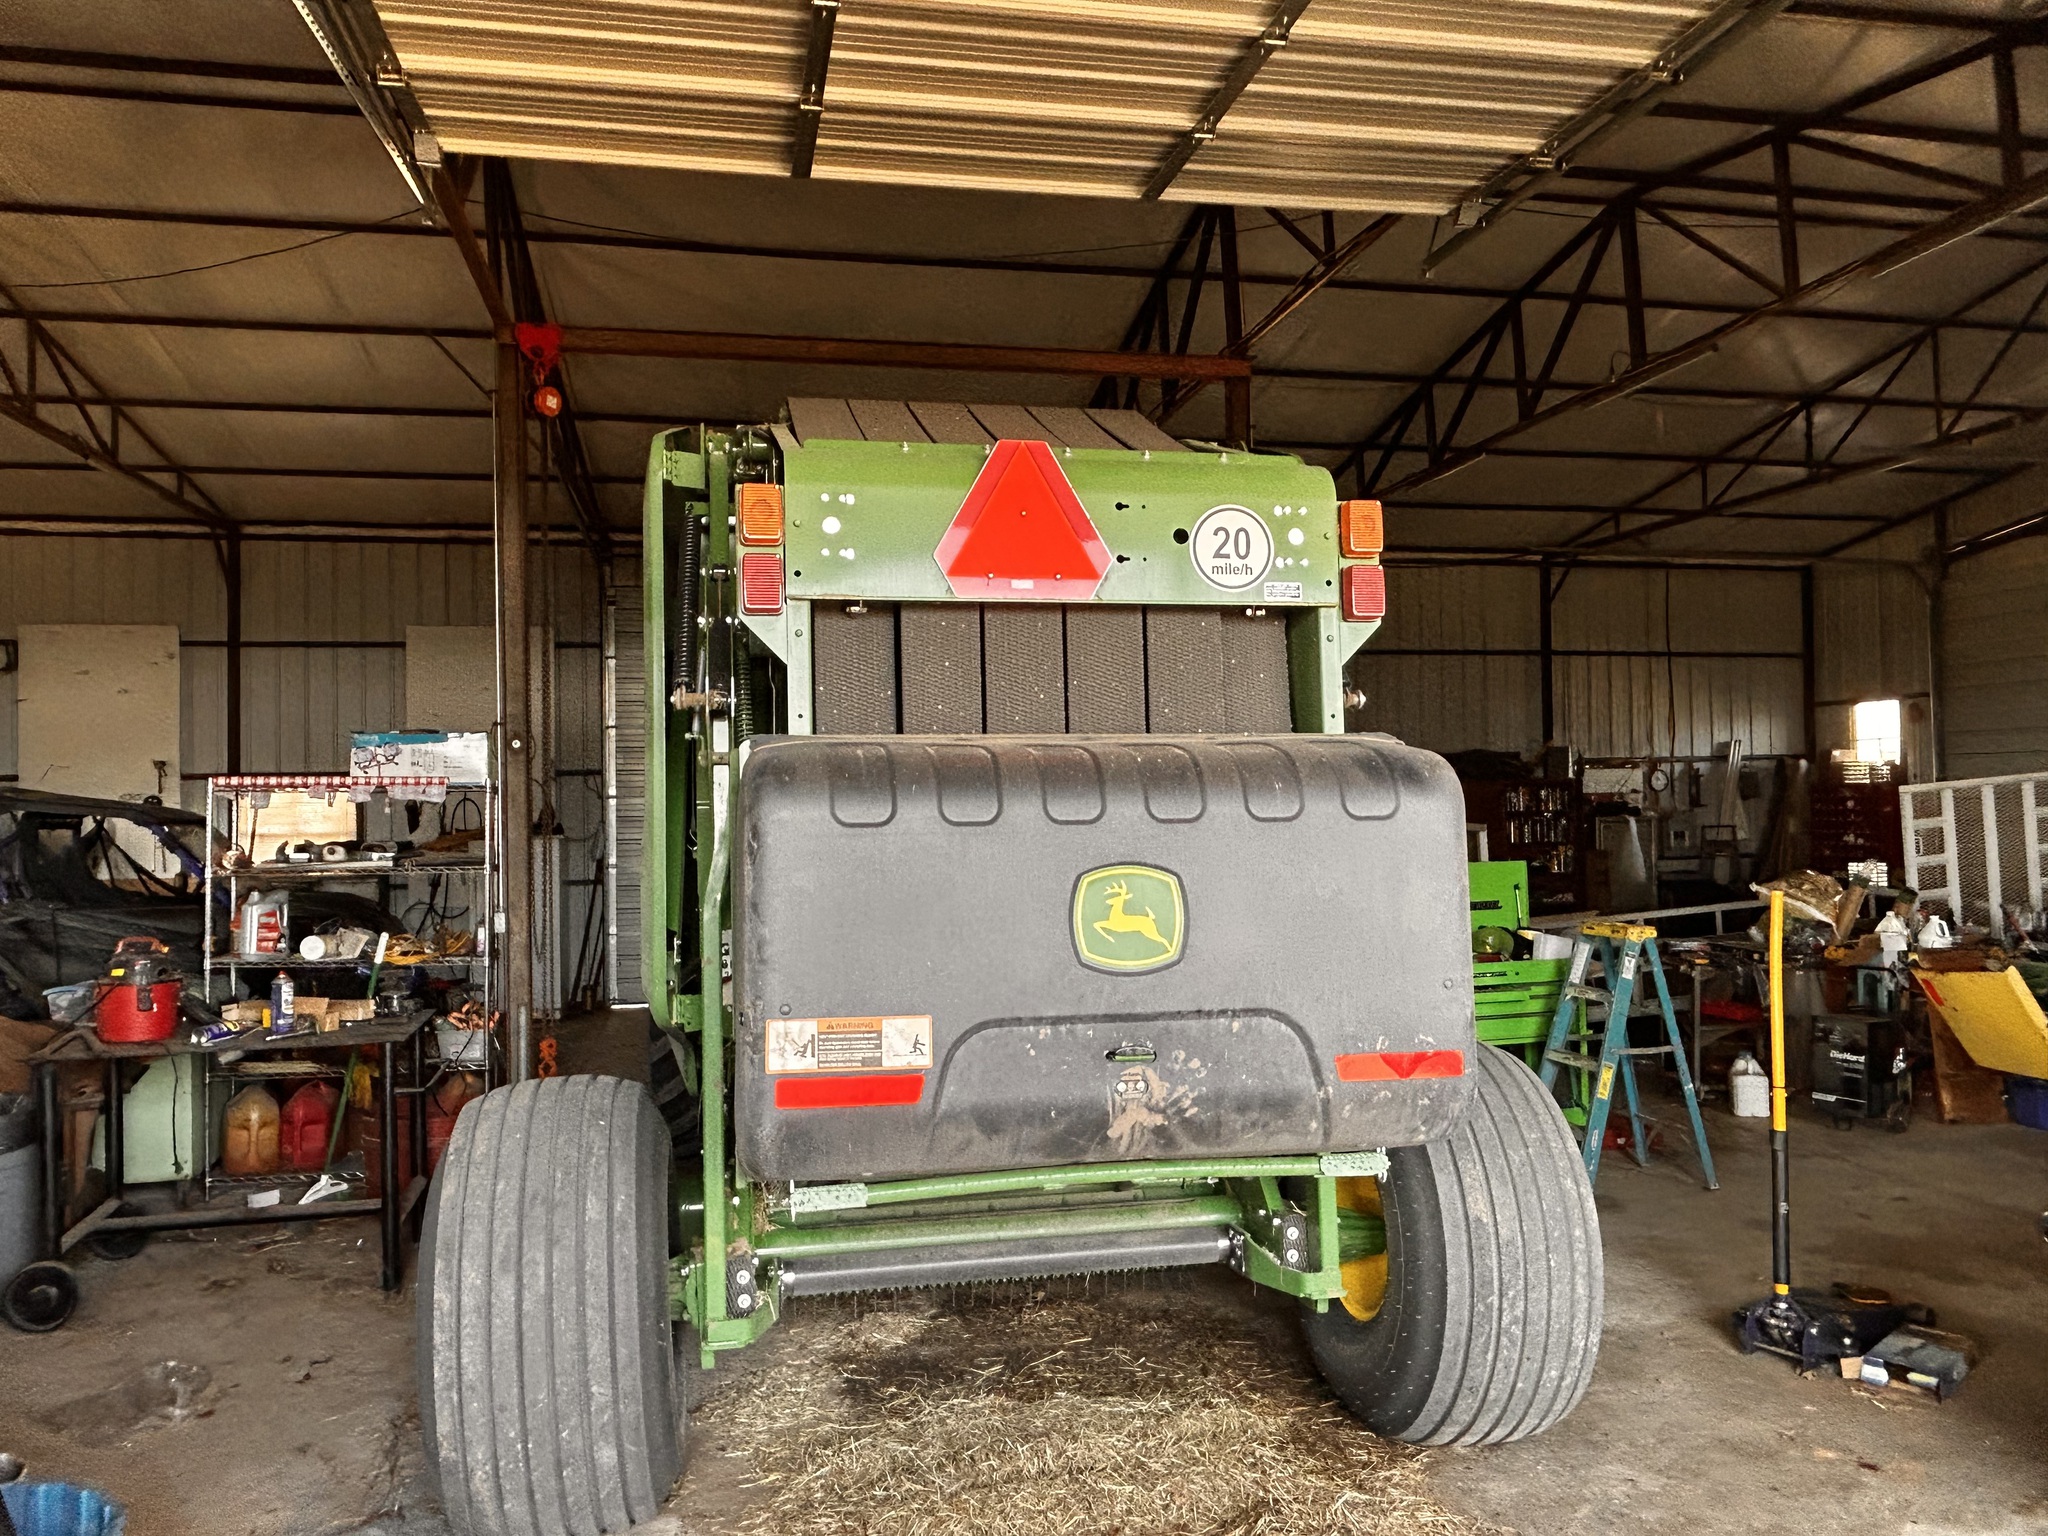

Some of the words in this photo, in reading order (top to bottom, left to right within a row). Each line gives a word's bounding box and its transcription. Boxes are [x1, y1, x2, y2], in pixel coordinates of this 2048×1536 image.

[1212, 526, 1251, 560] 20
[1211, 563, 1253, 576] mile/h
[834, 1021, 874, 1030] WARNING
